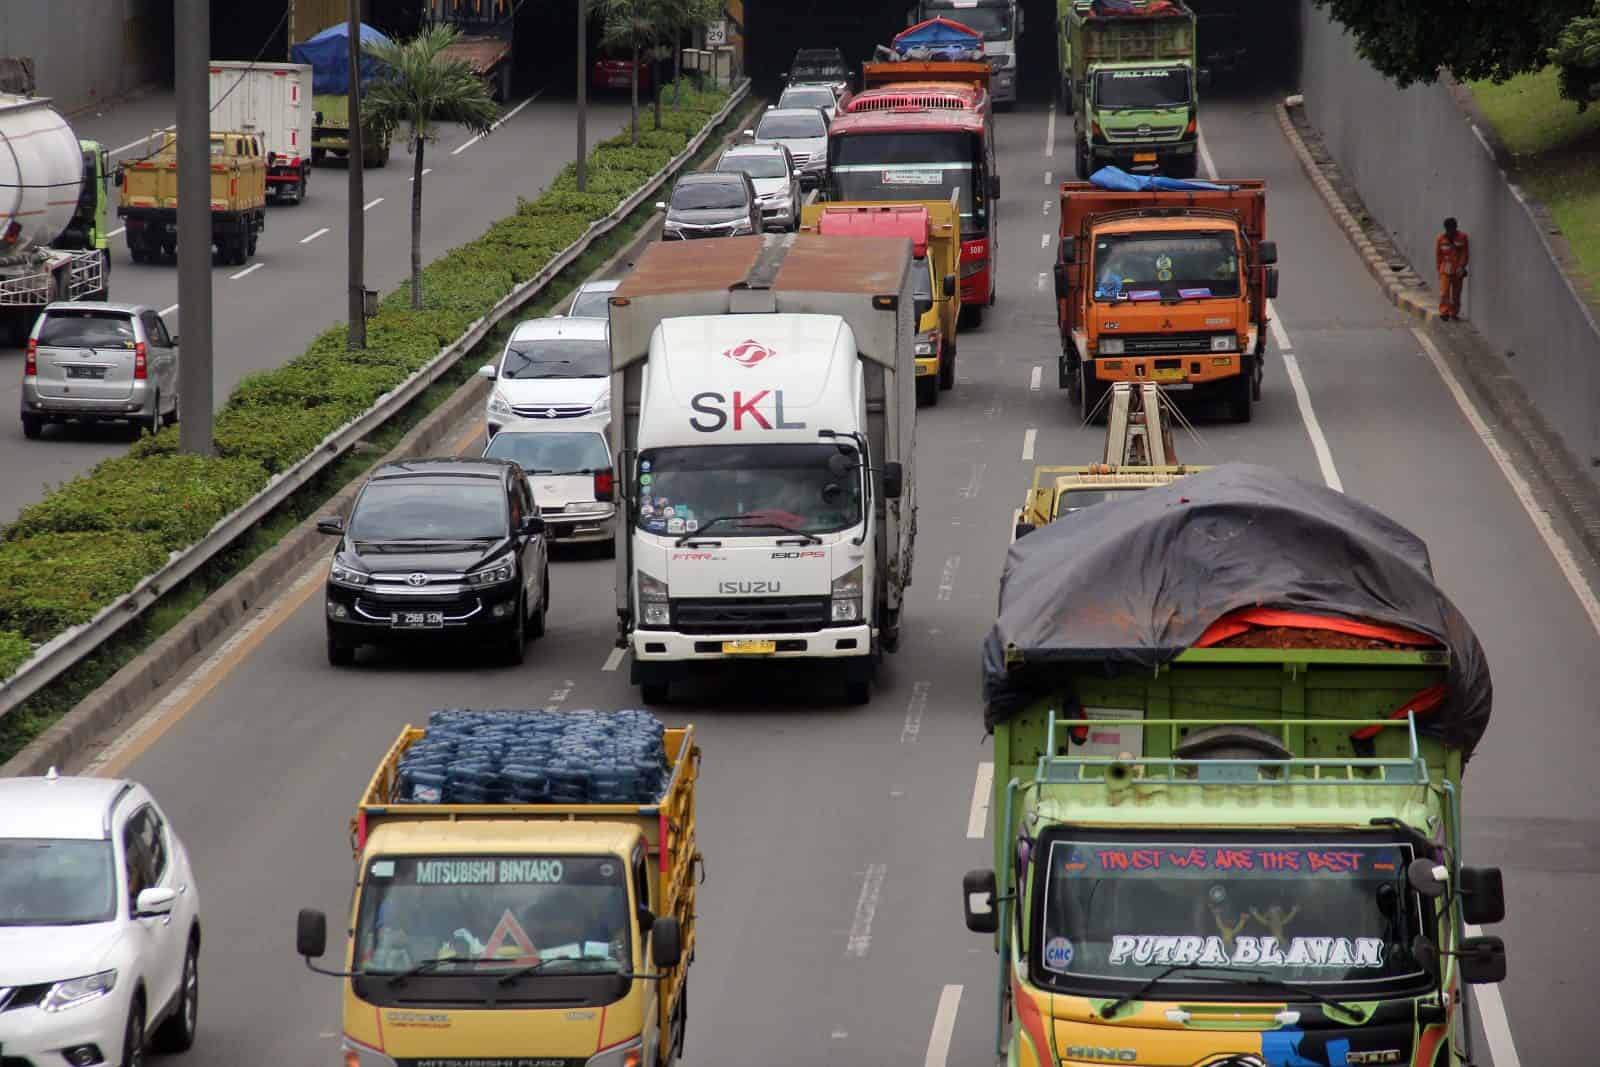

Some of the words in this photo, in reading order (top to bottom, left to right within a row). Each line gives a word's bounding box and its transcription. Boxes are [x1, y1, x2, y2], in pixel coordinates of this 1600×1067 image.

[689, 389, 807, 432] SKL
[718, 581, 781, 594] ISUZU
[1096, 850, 1163, 870] TRUST
[1170, 849, 1207, 867] WE
[1215, 850, 1255, 870] ARE
[1259, 851, 1299, 871] THE
[1306, 852, 1366, 872] BEST
[416, 861, 495, 884] MITSUBISHI
[499, 861, 563, 882] BINTARO
[1046, 948, 1072, 962] CMC
[1109, 935, 1228, 967] PUTRA
[1066, 1046, 1137, 1061] HINO
